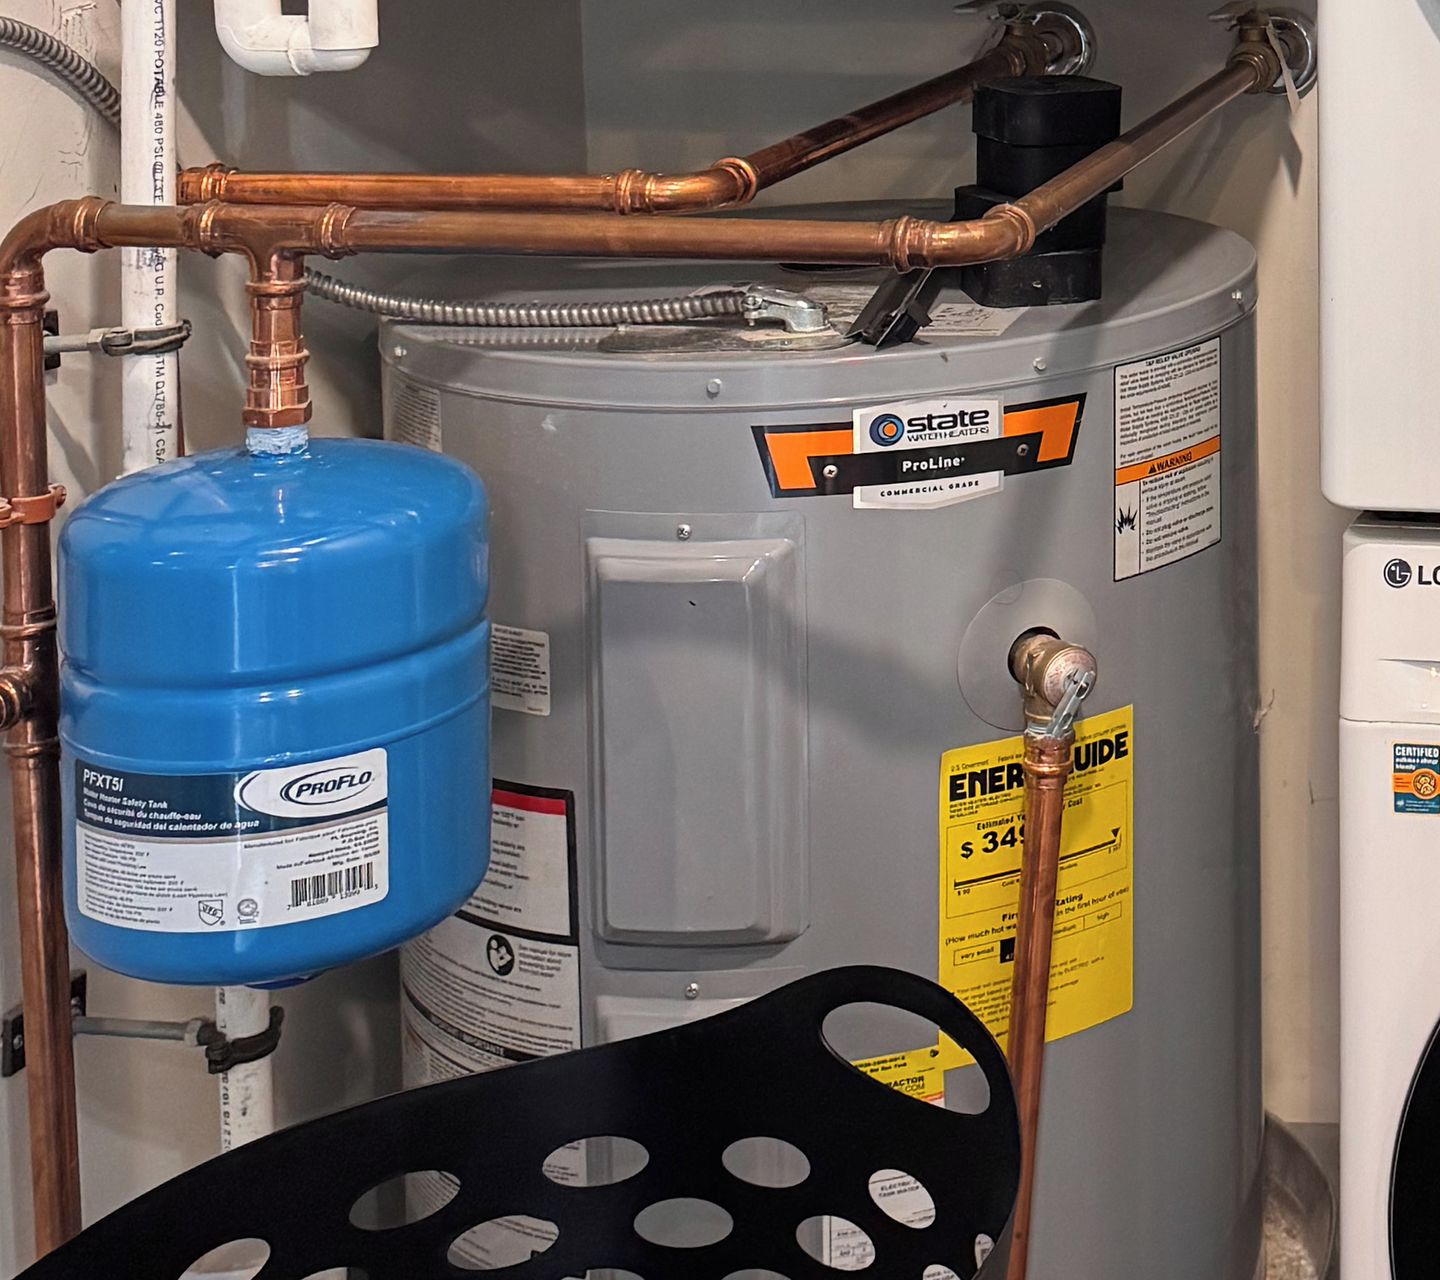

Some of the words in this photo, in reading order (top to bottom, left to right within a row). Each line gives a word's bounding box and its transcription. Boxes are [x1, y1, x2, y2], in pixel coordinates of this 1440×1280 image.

[153, 50, 165, 110] POTABLE
[906, 409, 990, 434] state
[906, 432, 943, 442] WATER
[944, 426, 989, 439] HEATERS
[155, 438, 165, 464] CSA
[1156, 451, 1193, 473] WARNING
[880, 485, 944, 498] COMMERCIAL
[948, 480, 980, 490] GRADE
[1395, 746, 1440, 758] CERTIFIED
[295, 771, 373, 799] PROFLO
[121, 797, 148, 809] Safety
[148, 799, 168, 809] Tank
[1067, 798, 1083, 809] Cost
[136, 811, 147, 819] du
[977, 816, 1014, 831] Estimated
[152, 821, 167, 831] del
[168, 821, 218, 832] calentador
[219, 821, 232, 830] de
[234, 820, 260, 832] agua
[960, 841, 974, 859] $
[1064, 905, 1076, 914] the
[1077, 901, 1092, 911] first
[1092, 895, 1108, 907] hour
[1108, 891, 1116, 901] of
[945, 932, 966, 946] (How
[968, 928, 990, 940] much
[991, 925, 1004, 935] hot
